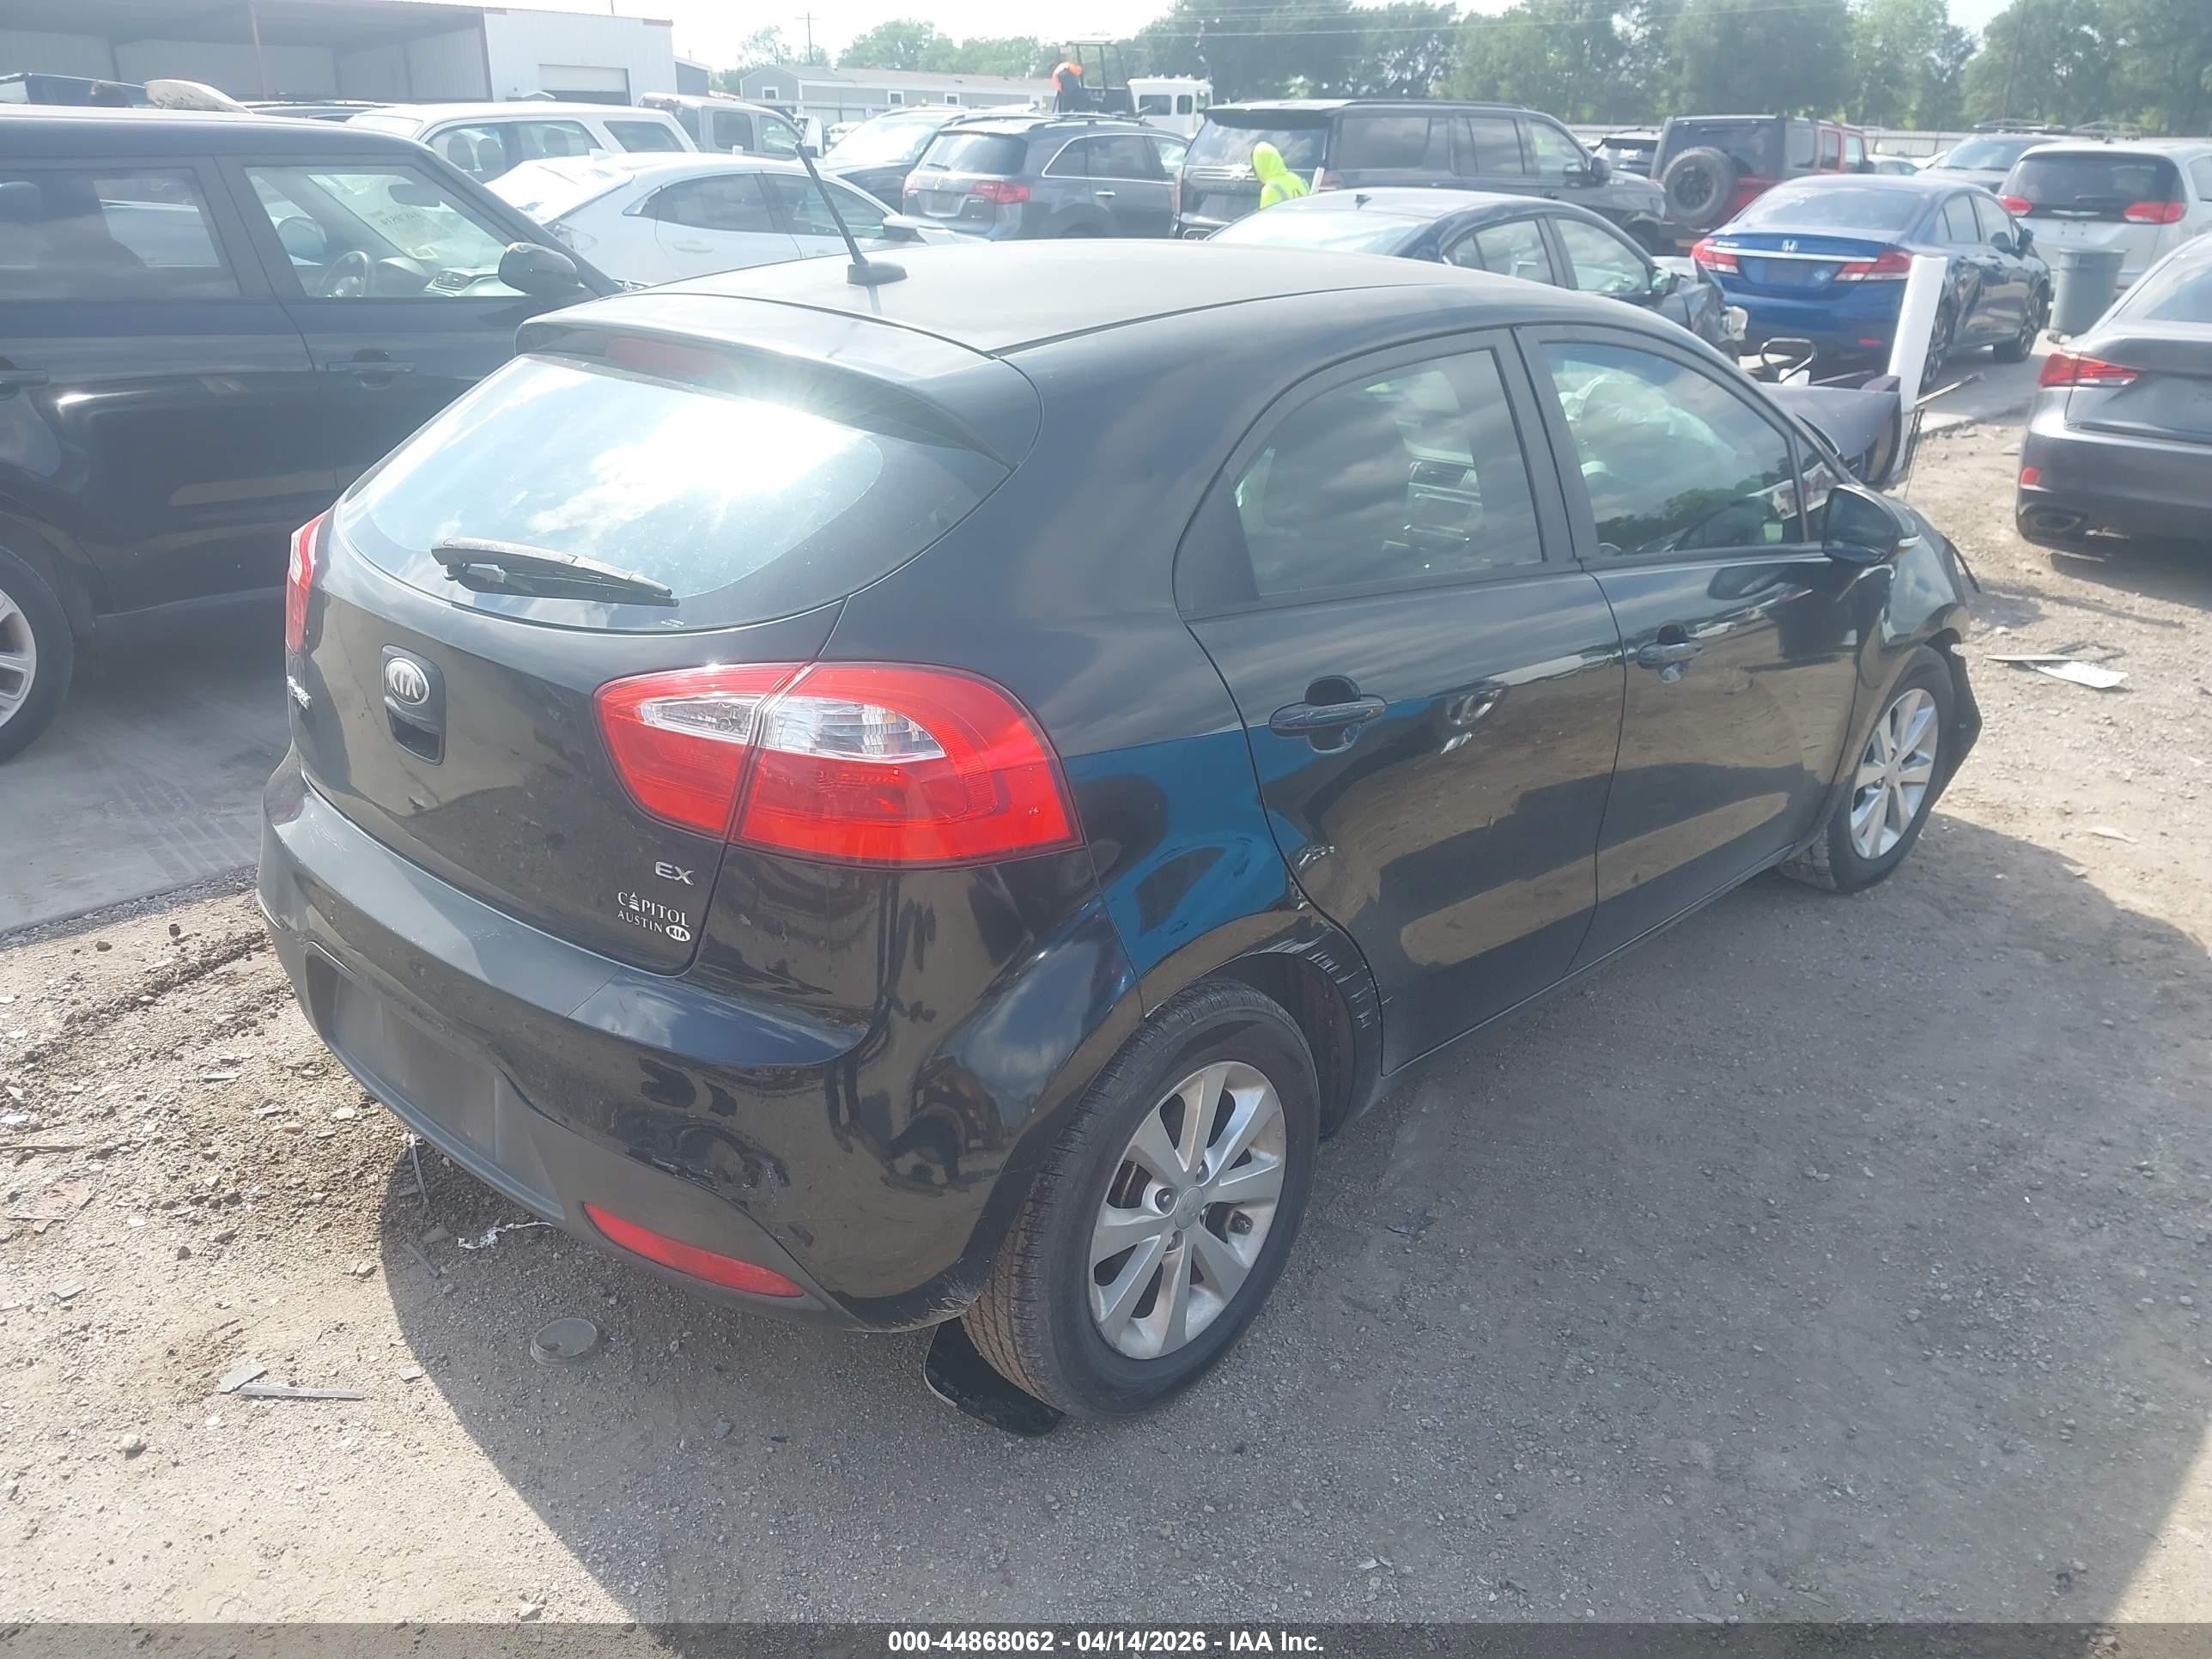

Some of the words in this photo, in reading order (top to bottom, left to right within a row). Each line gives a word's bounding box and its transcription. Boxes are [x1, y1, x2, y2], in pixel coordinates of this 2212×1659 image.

[387, 663, 421, 701] KIA
[655, 861, 694, 885] EX
[618, 891, 690, 927] CAPITOL
[618, 909, 662, 933] AUSTIN
[667, 927, 688, 940] KIA
